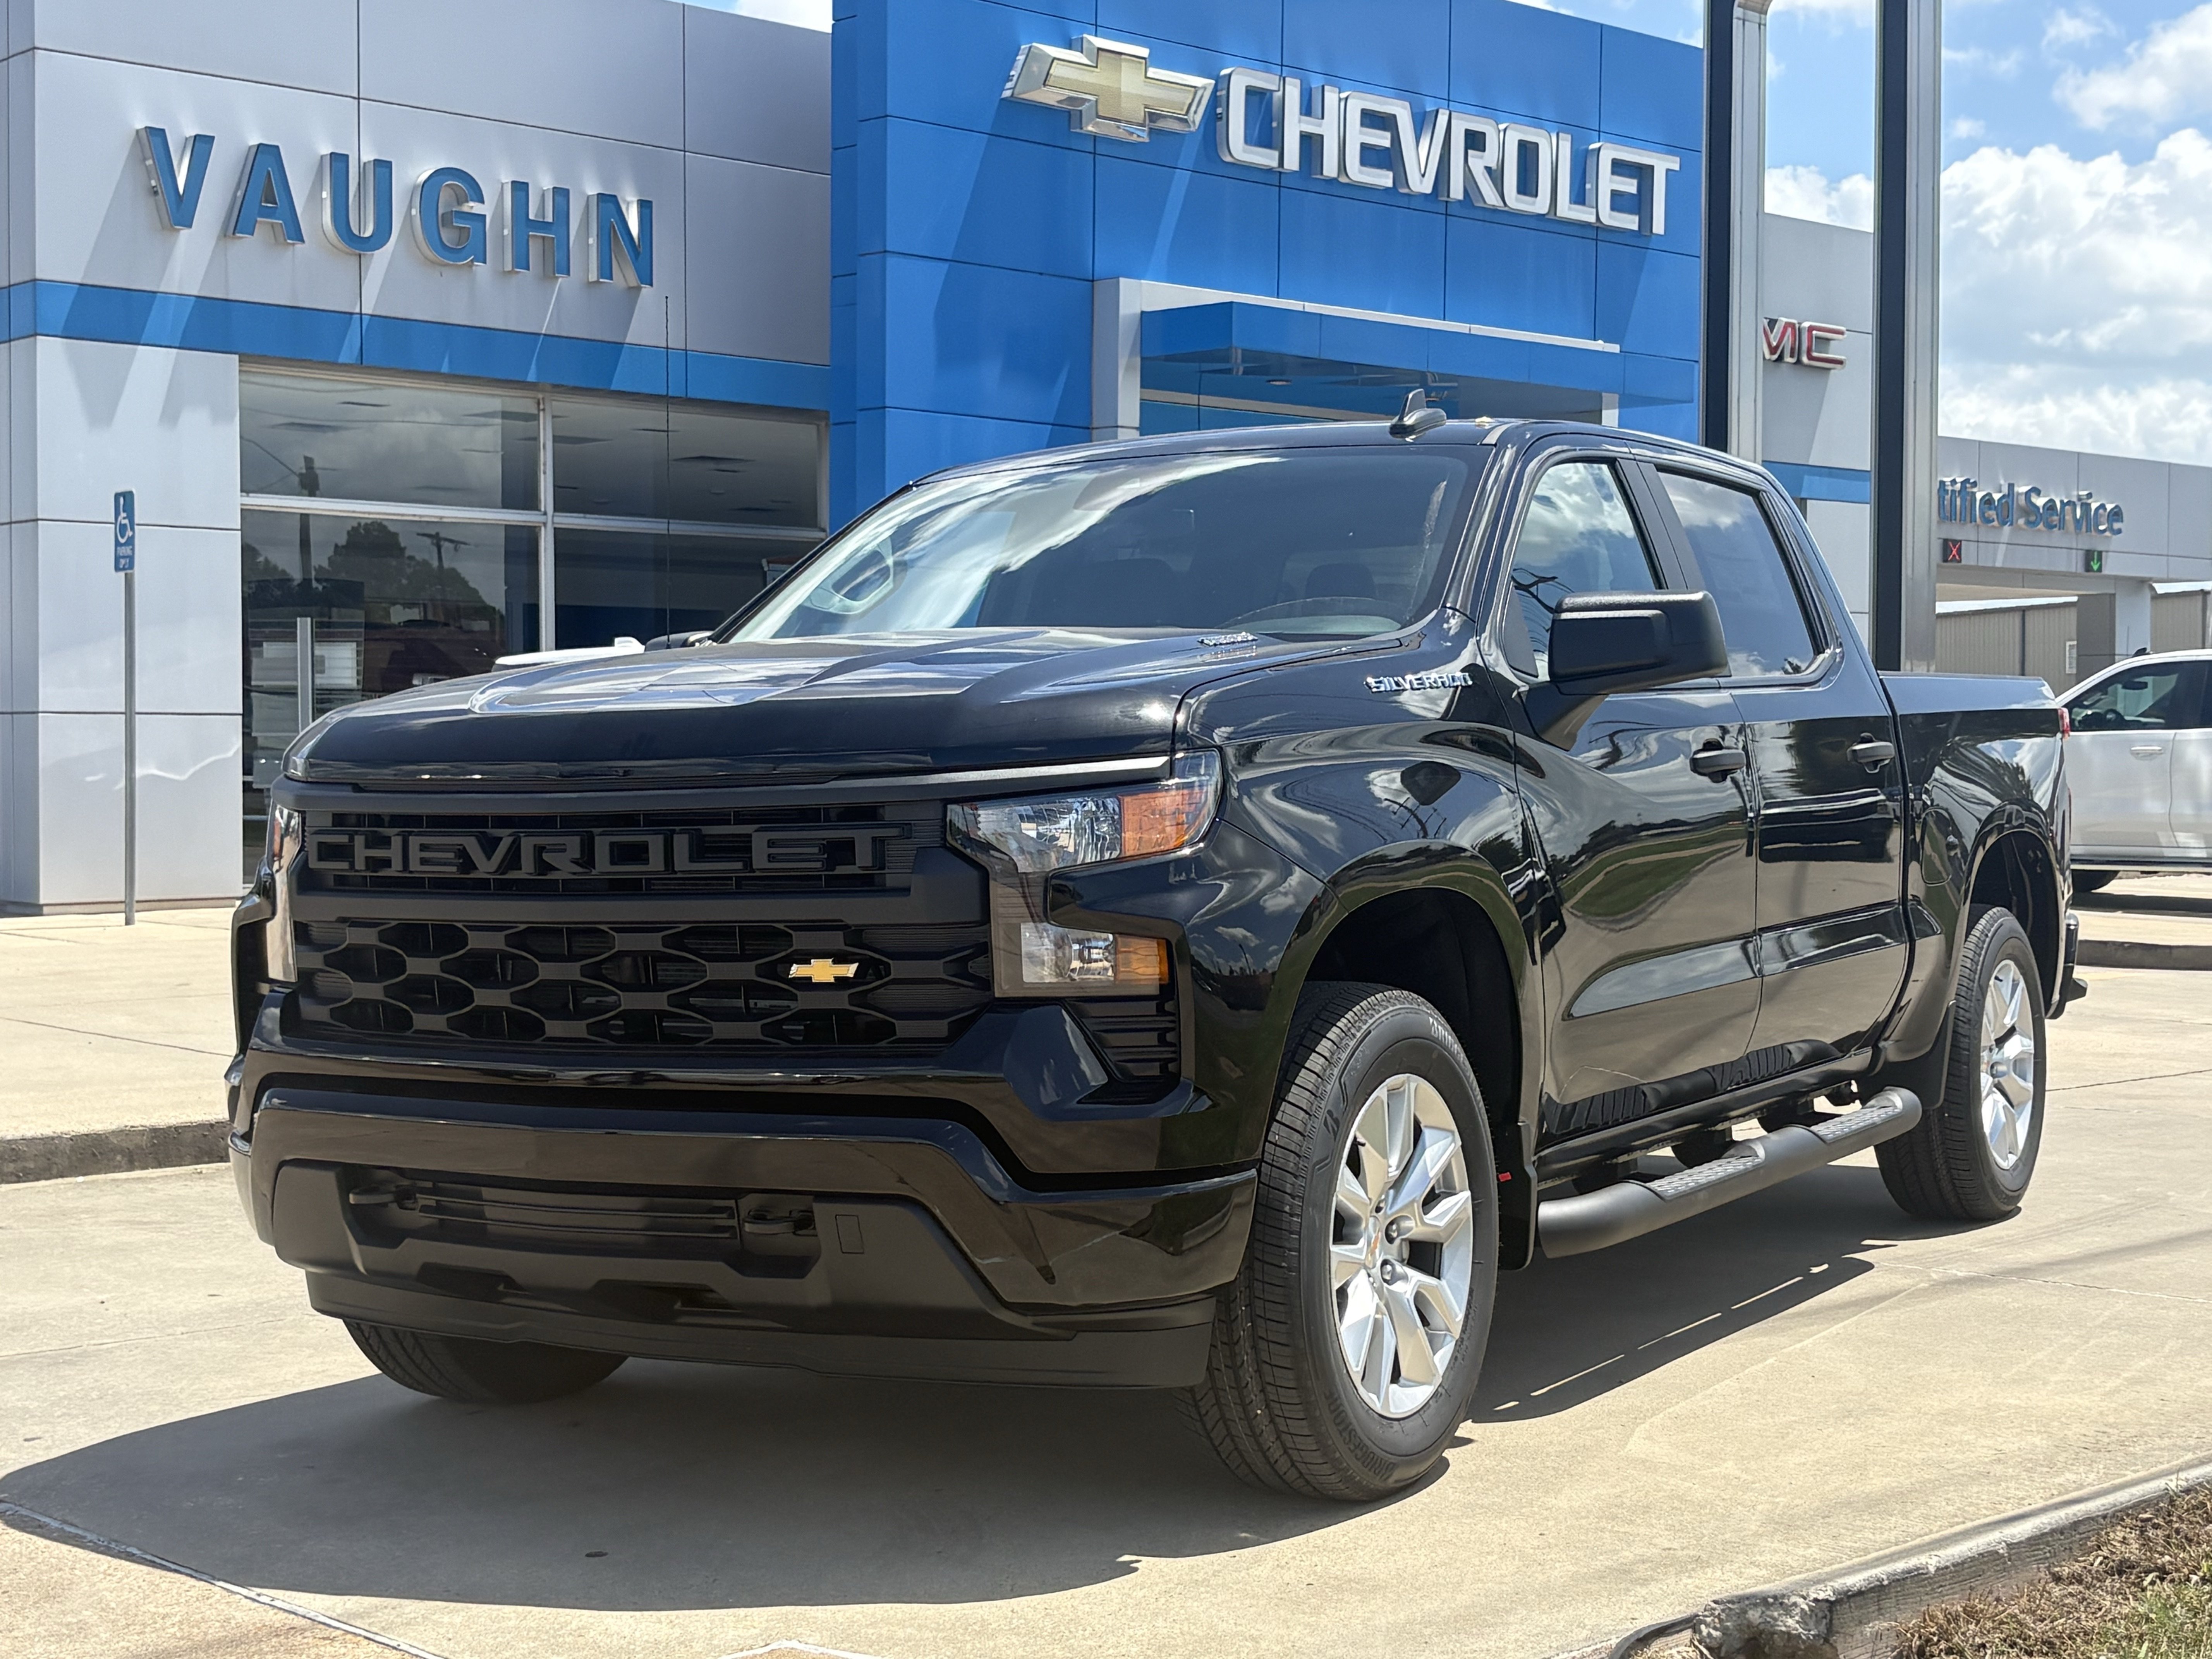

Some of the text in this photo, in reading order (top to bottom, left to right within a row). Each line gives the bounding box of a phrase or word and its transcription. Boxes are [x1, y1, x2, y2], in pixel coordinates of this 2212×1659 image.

[1217, 67, 1680, 235] CHEVROLET
[136, 126, 654, 288] VAUGHN
[2016, 486, 2124, 536] Service
[1364, 672, 1472, 693] SILVERADO
[308, 826, 907, 874] CHEVROLET
